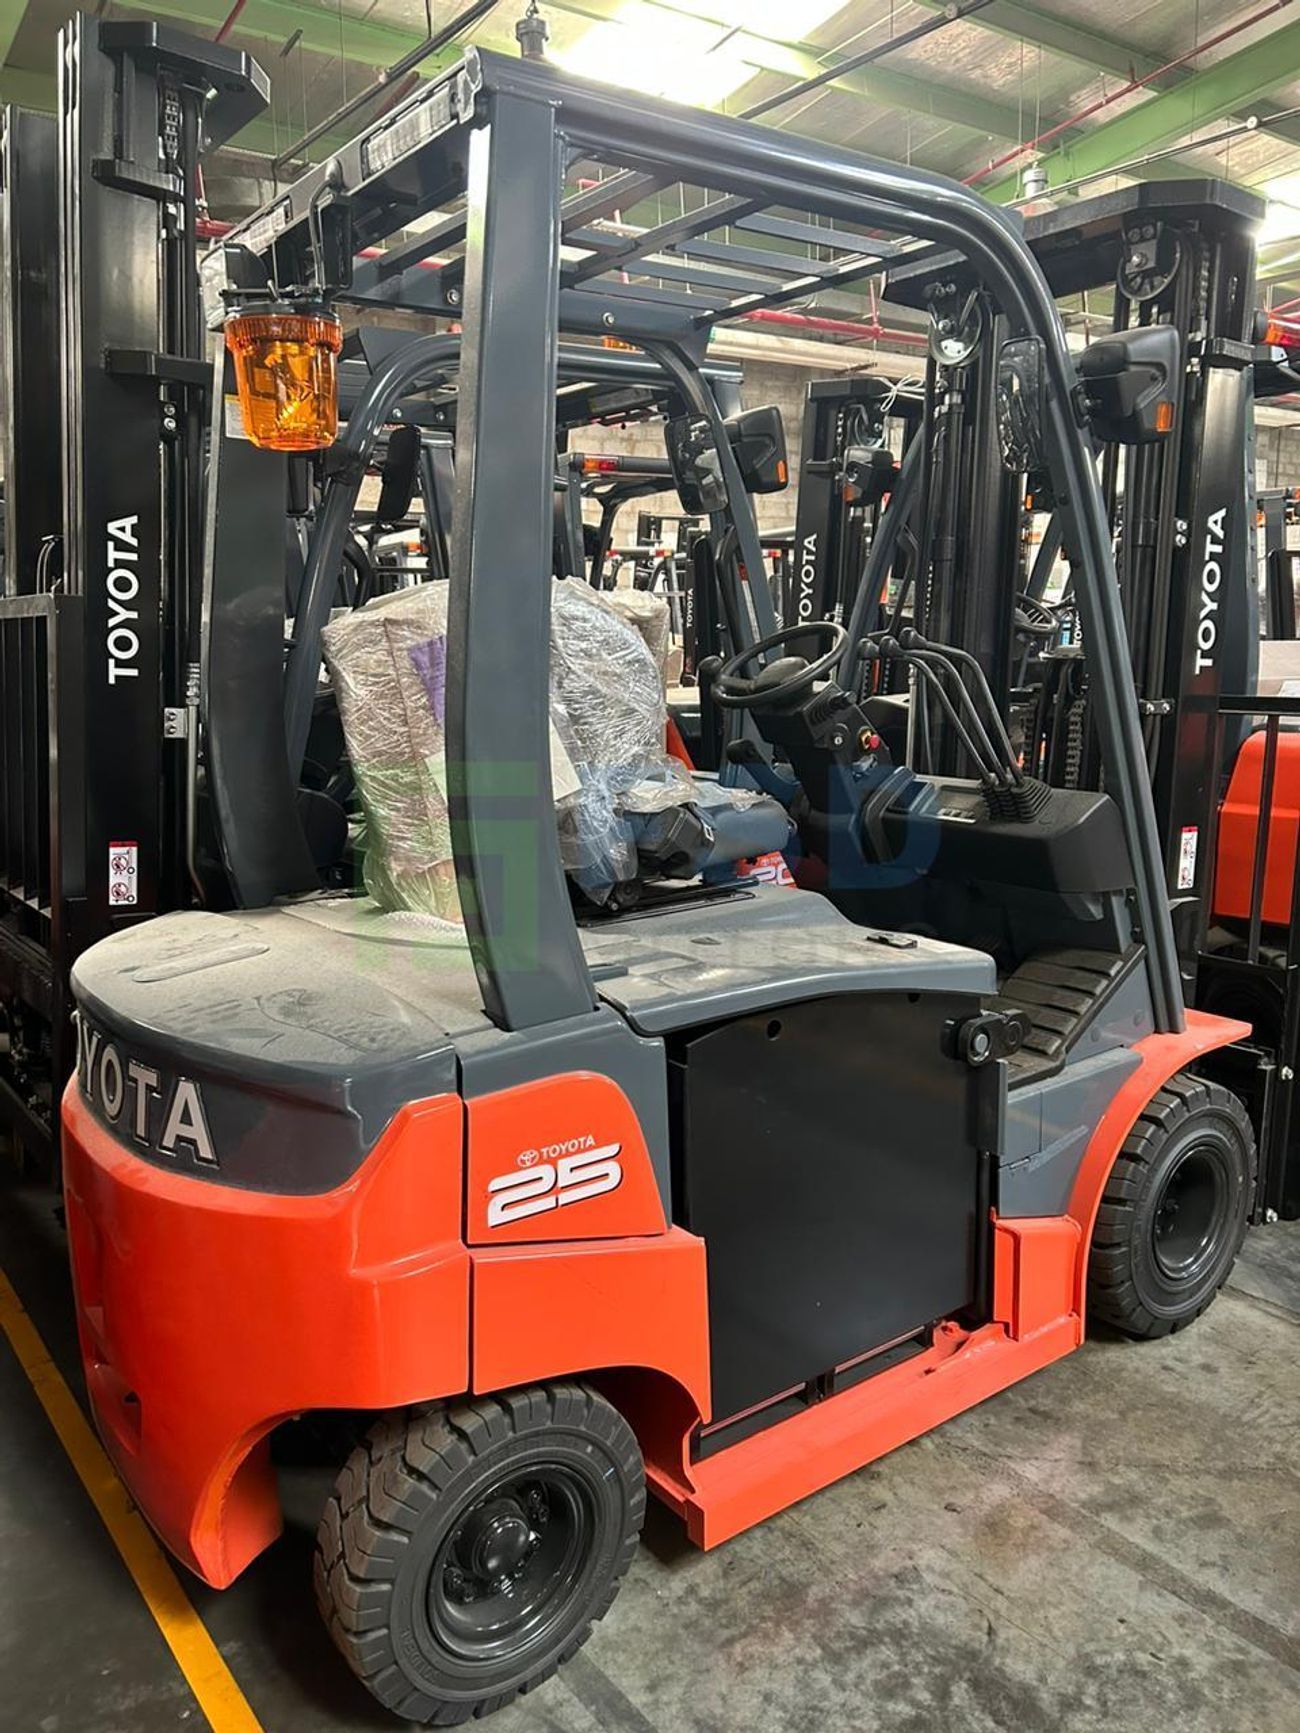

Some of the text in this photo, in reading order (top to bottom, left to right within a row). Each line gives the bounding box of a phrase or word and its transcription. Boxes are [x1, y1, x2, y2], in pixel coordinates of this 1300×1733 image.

[106, 514, 140, 684] TOYOTA
[686, 588, 694, 629] TOYOTA
[798, 533, 818, 627] TOYOTA
[1195, 507, 1228, 675] TOYOTA
[487, 1142, 622, 1228] 25
[541, 1135, 596, 1159] TOYOTA
